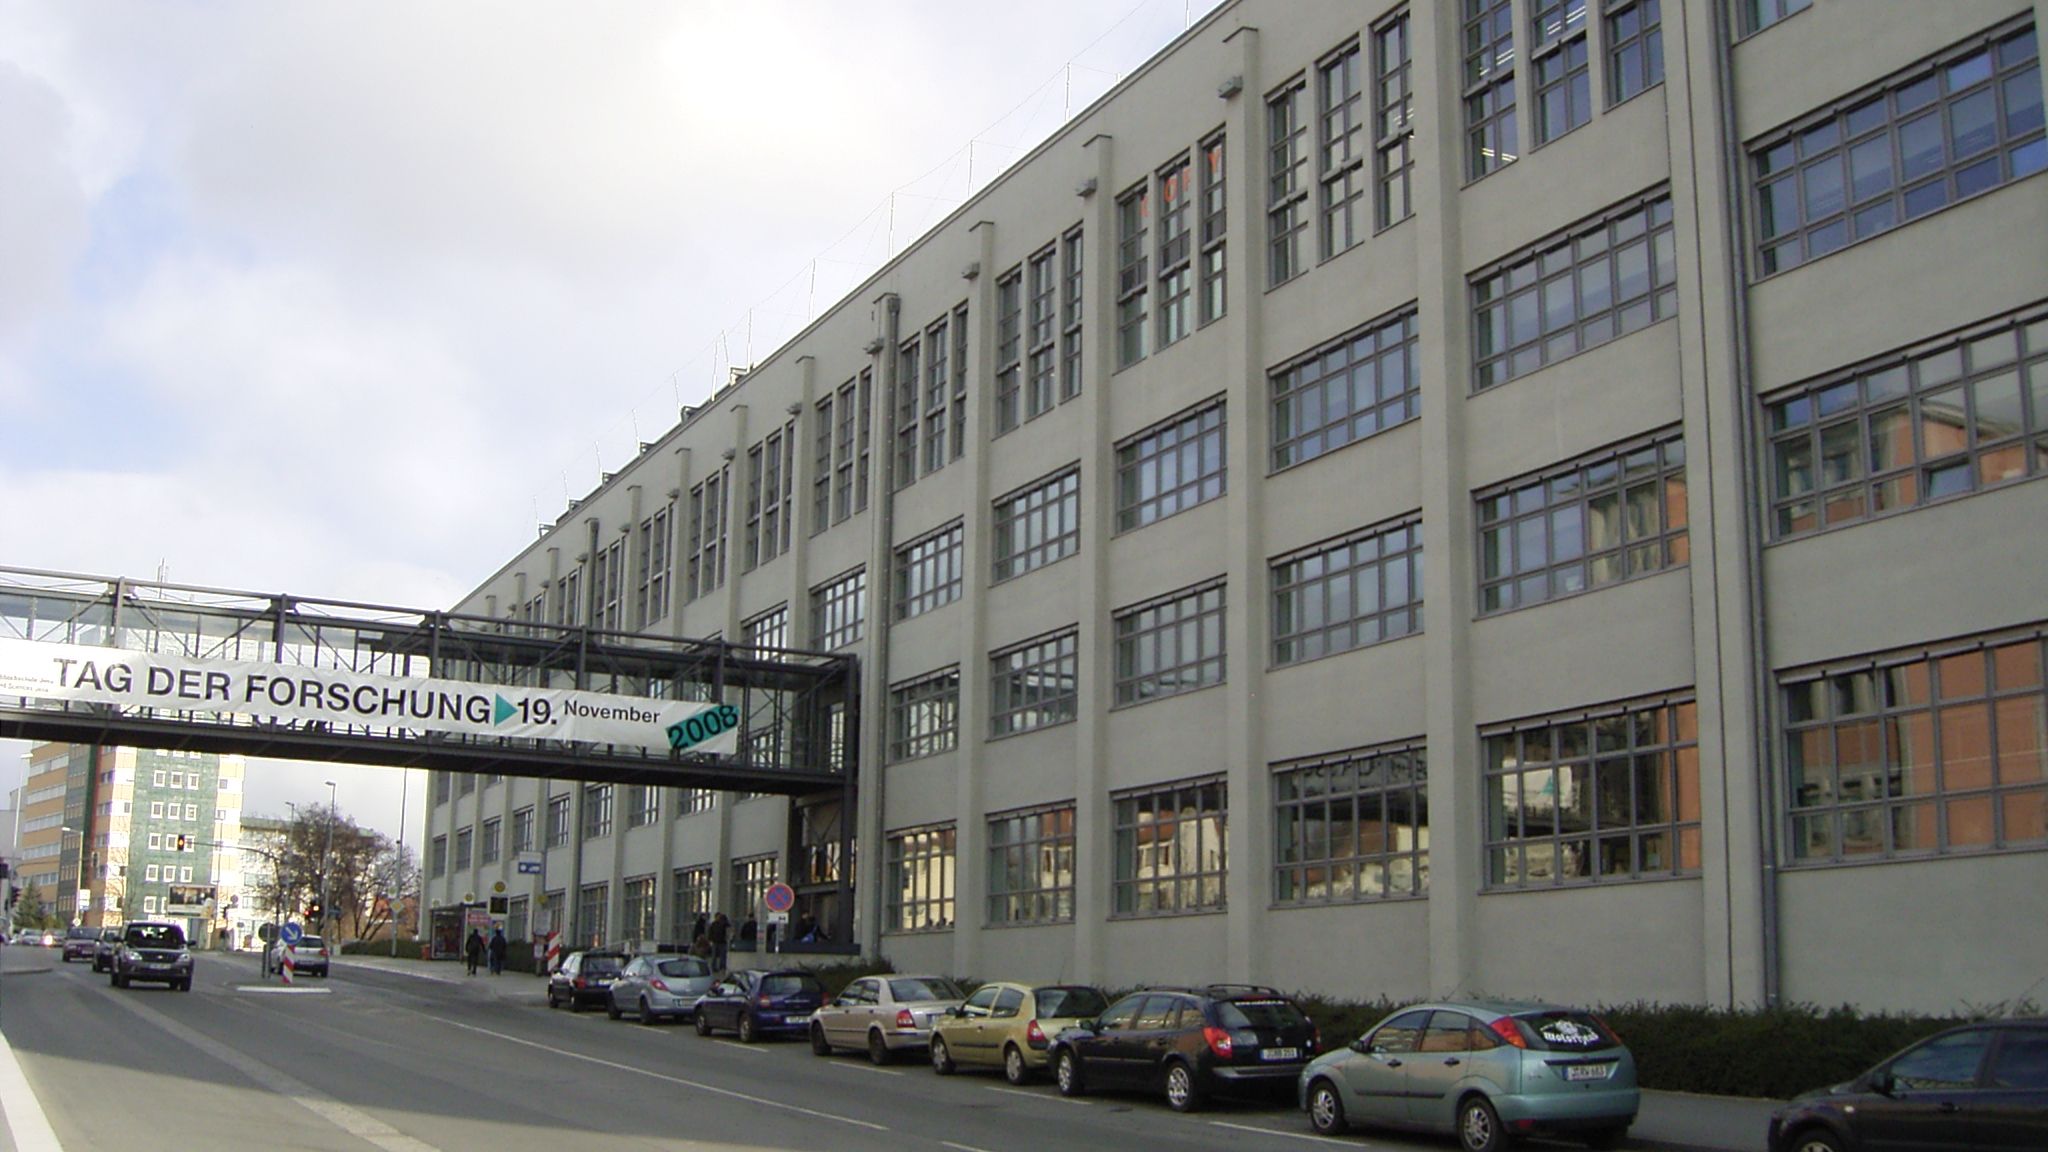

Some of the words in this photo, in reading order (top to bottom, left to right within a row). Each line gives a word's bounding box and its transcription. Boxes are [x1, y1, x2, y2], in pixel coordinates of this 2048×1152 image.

[53, 658, 132, 693] TAG
[147, 666, 231, 700] DER
[245, 674, 491, 725] FORSCHUNG
[517, 698, 558, 725] 19.
[564, 700, 661, 724] November
[667, 704, 739, 750] 2008
